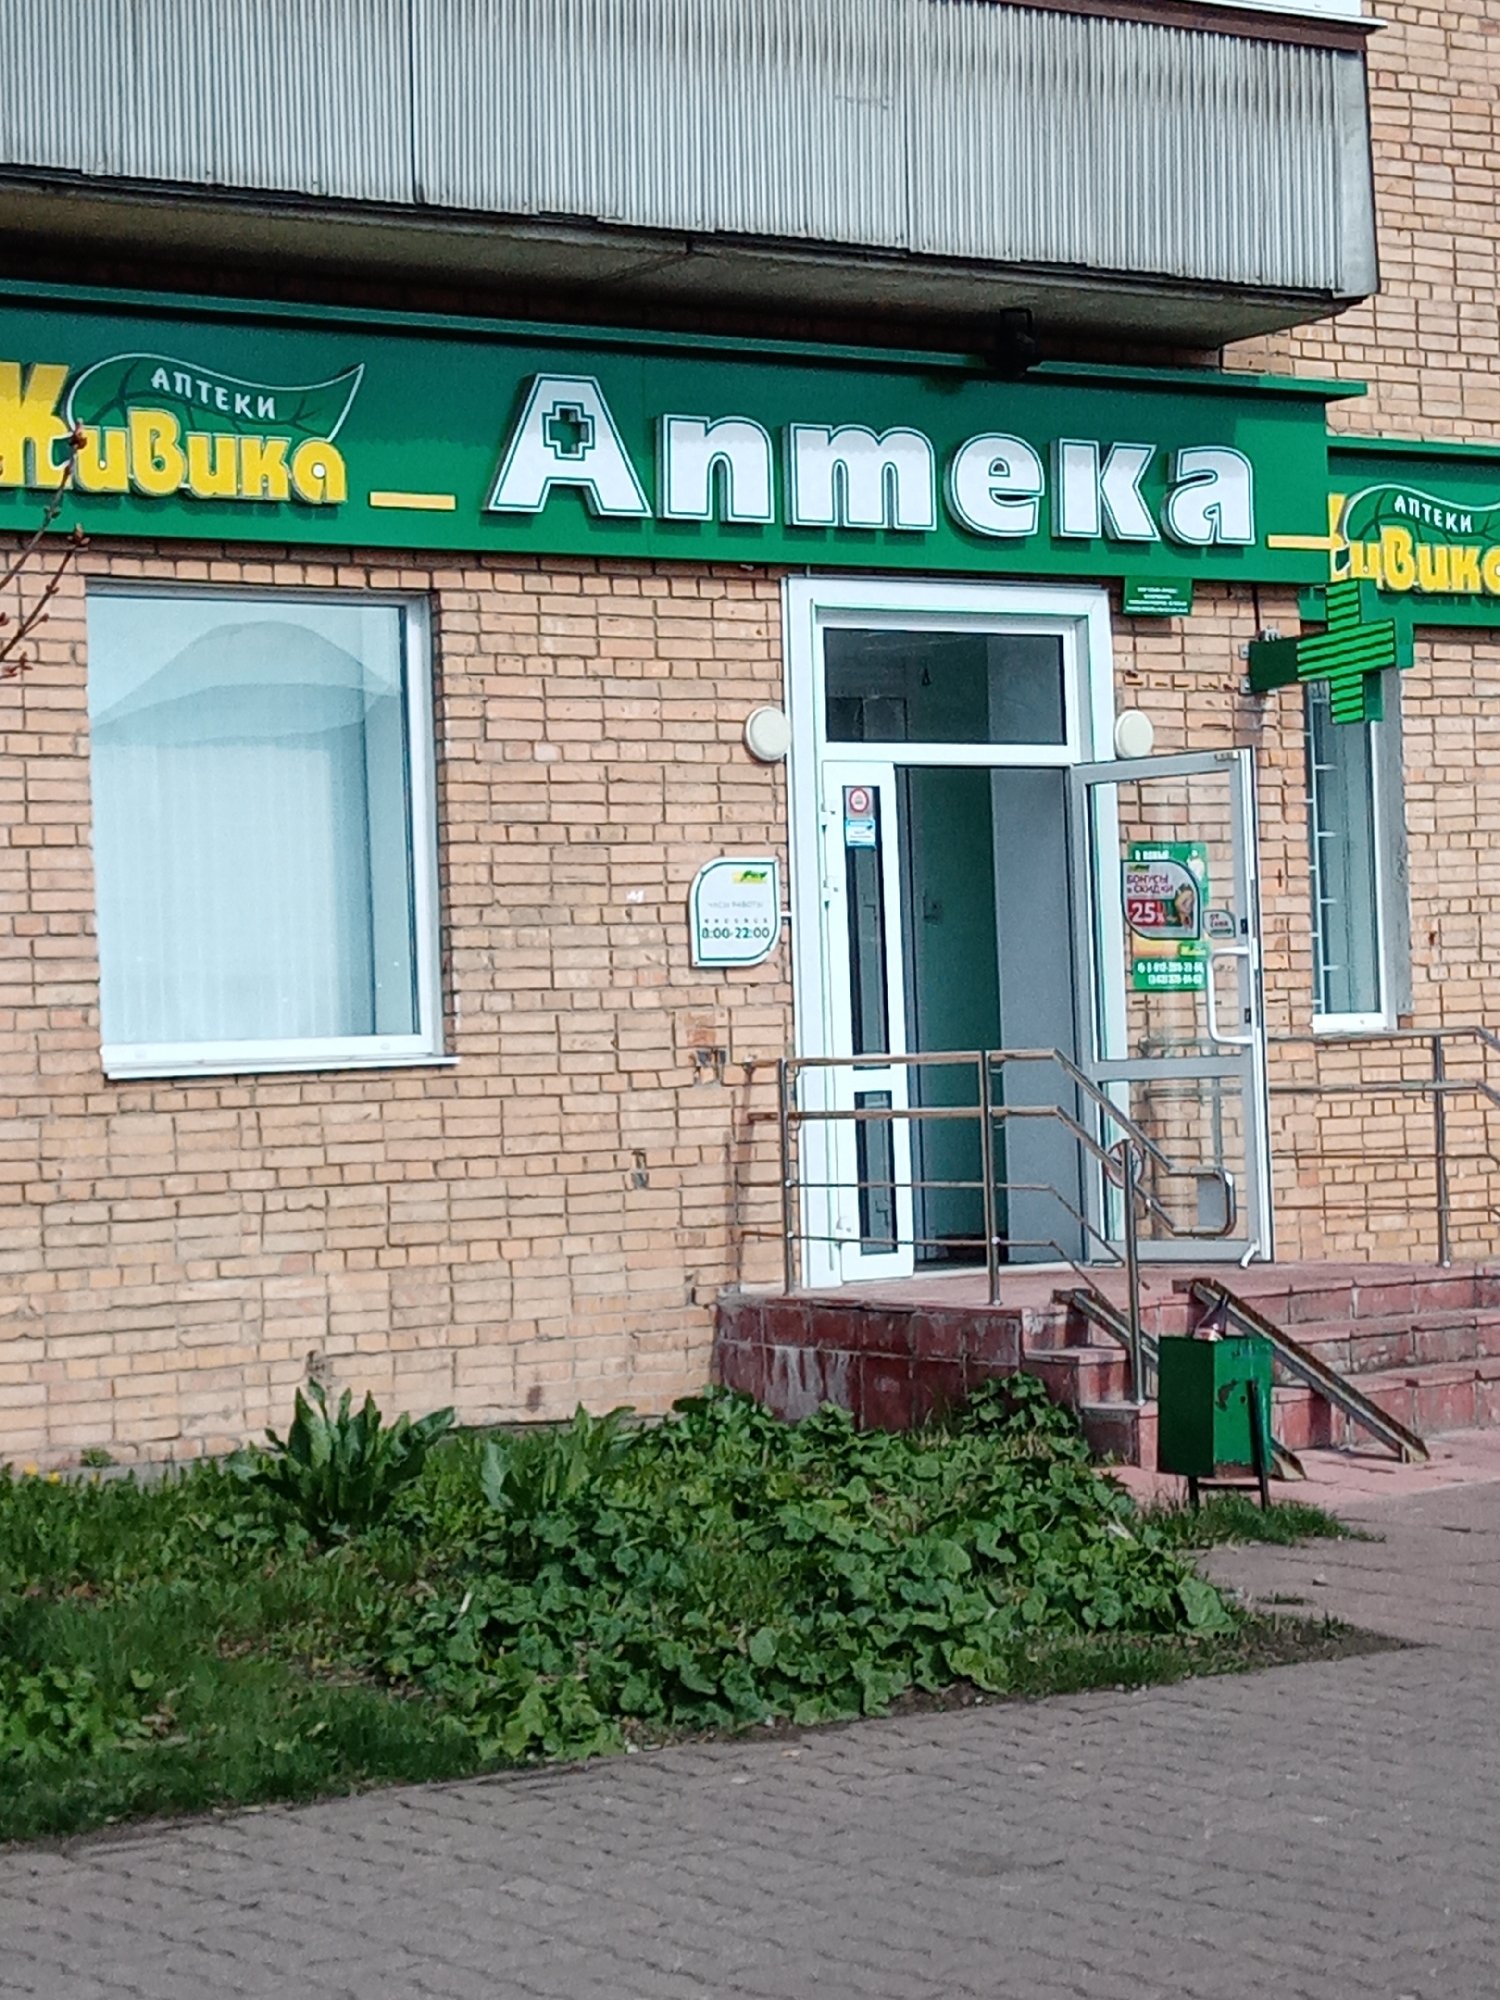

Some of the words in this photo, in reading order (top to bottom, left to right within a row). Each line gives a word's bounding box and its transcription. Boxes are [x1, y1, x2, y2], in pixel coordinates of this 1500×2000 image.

[150, 366, 276, 420] АПТЕКИ
[487, 373, 1255, 545] Аптека
[1394, 494, 1473, 533] АПТЕКИ
[1127, 874, 1168, 884] БОНУСЫ
[1134, 885, 1173, 894] СКИДКИ
